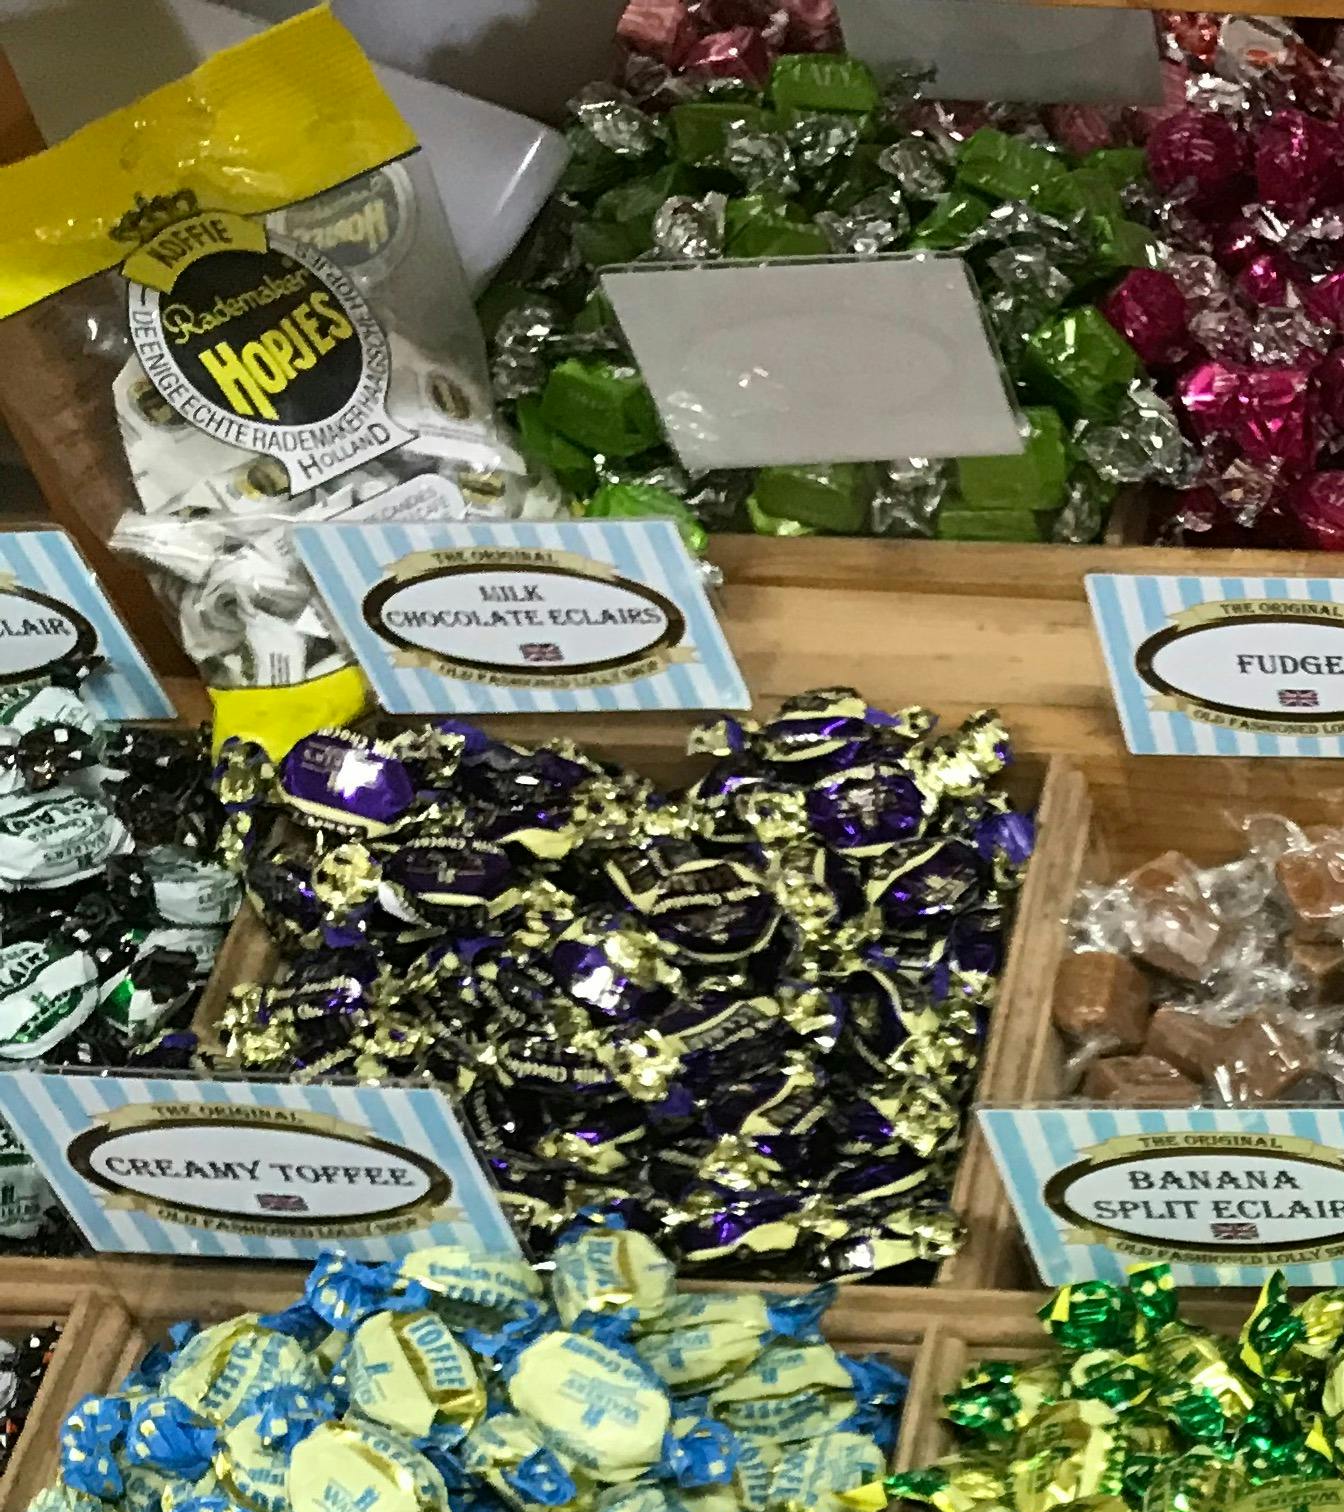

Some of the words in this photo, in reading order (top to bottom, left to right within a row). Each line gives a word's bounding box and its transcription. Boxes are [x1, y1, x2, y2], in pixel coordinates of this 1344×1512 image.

[147, 218, 233, 269] KOFFIE
[132, 309, 154, 338] DE
[198, 291, 352, 421] HOPJES
[139, 342, 188, 403] ENIGE
[180, 398, 253, 443] ECHTE
[298, 422, 390, 479] HOLLAND
[479, 584, 546, 603] MILK
[385, 608, 544, 628] CHOCOLATE
[550, 608, 662, 626] ECLAIRS
[1220, 603, 1254, 615] THE
[1258, 603, 1344, 617] ORIGINAL
[0, 618, 71, 636] LAIR
[1138, 1135, 1179, 1149] THE
[1184, 1135, 1283, 1149] ORIGINAL
[105, 1157, 262, 1182] CREAMY
[270, 1163, 416, 1188] TOFFEE
[1128, 1170, 1303, 1190] BANANA
[1093, 1200, 1200, 1220] SPLIT
[1266, 1249, 1321, 1265] LOLLY
[409, 1317, 466, 1390] TOFFEE
